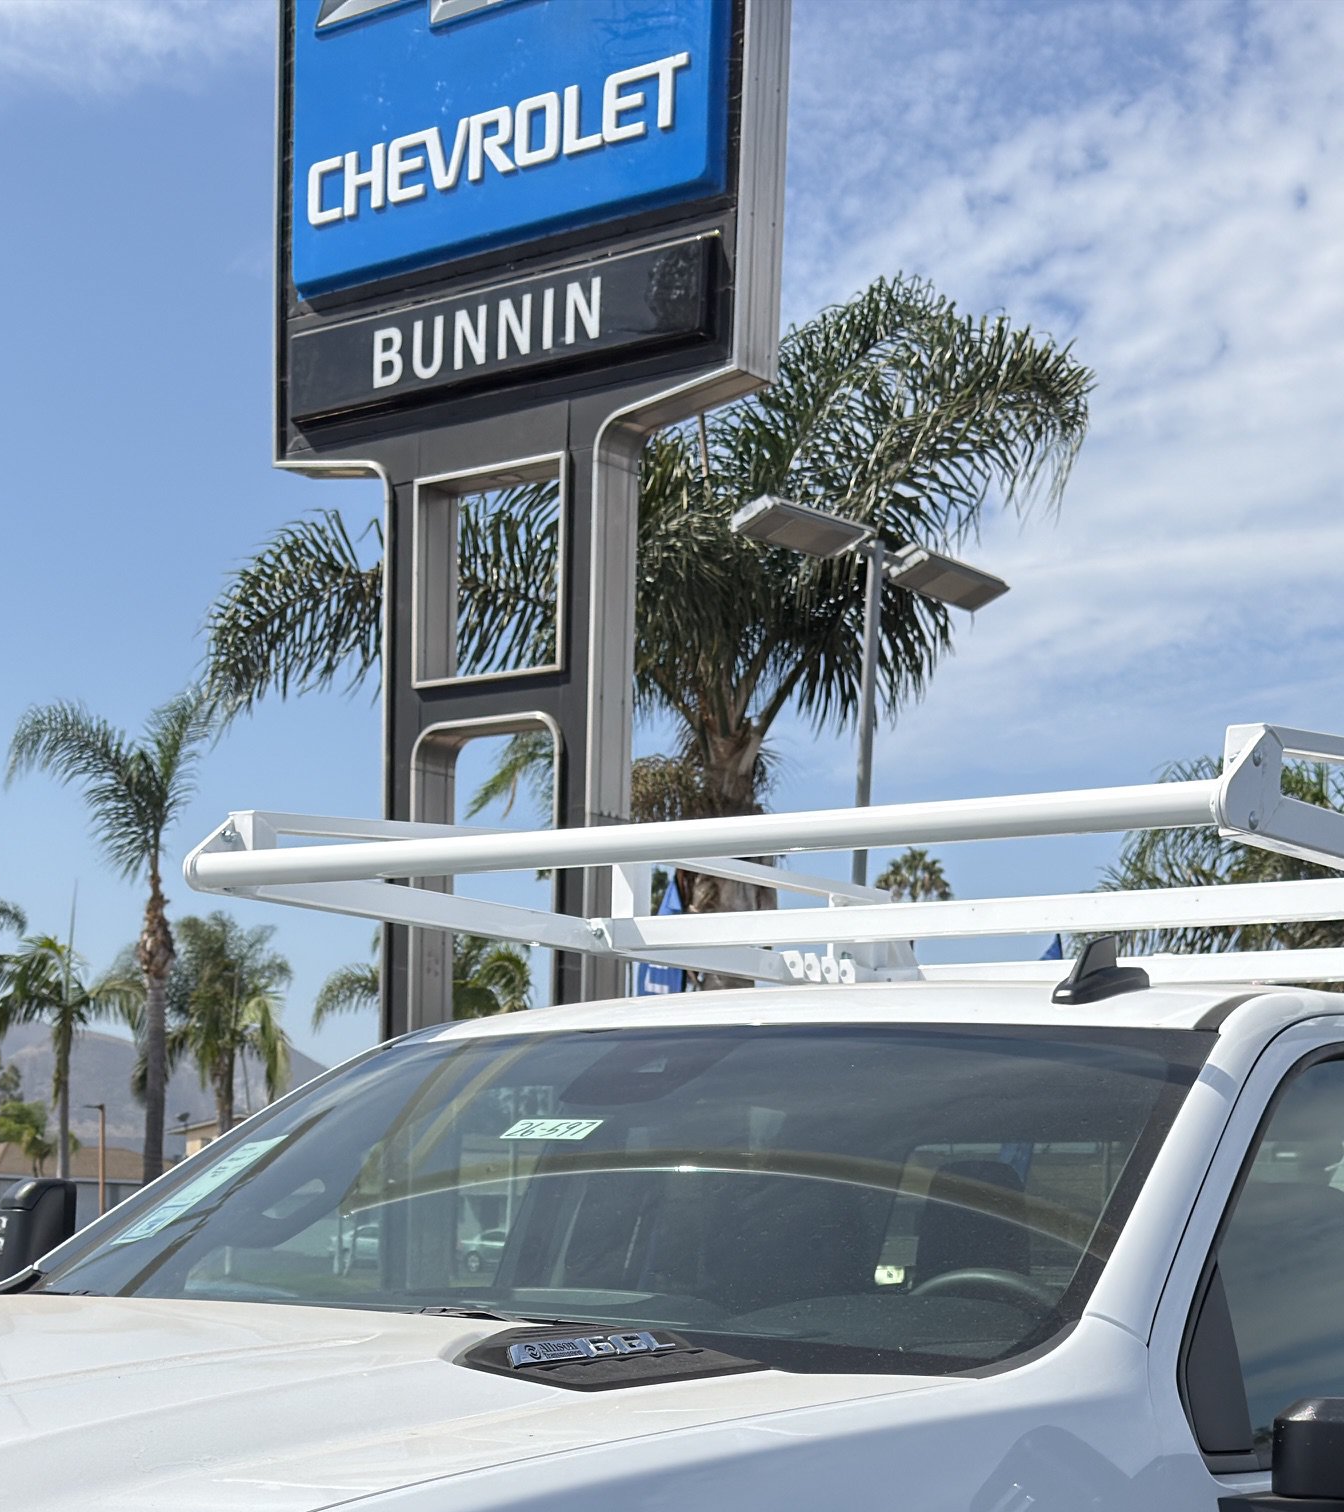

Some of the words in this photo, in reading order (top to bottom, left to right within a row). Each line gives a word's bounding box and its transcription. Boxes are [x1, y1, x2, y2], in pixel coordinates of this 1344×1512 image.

[307, 51, 690, 227] CHEVROLET
[372, 276, 602, 390] BUNNIN
[504, 1121, 599, 1138] 26-597
[538, 1341, 578, 1352] Allison
